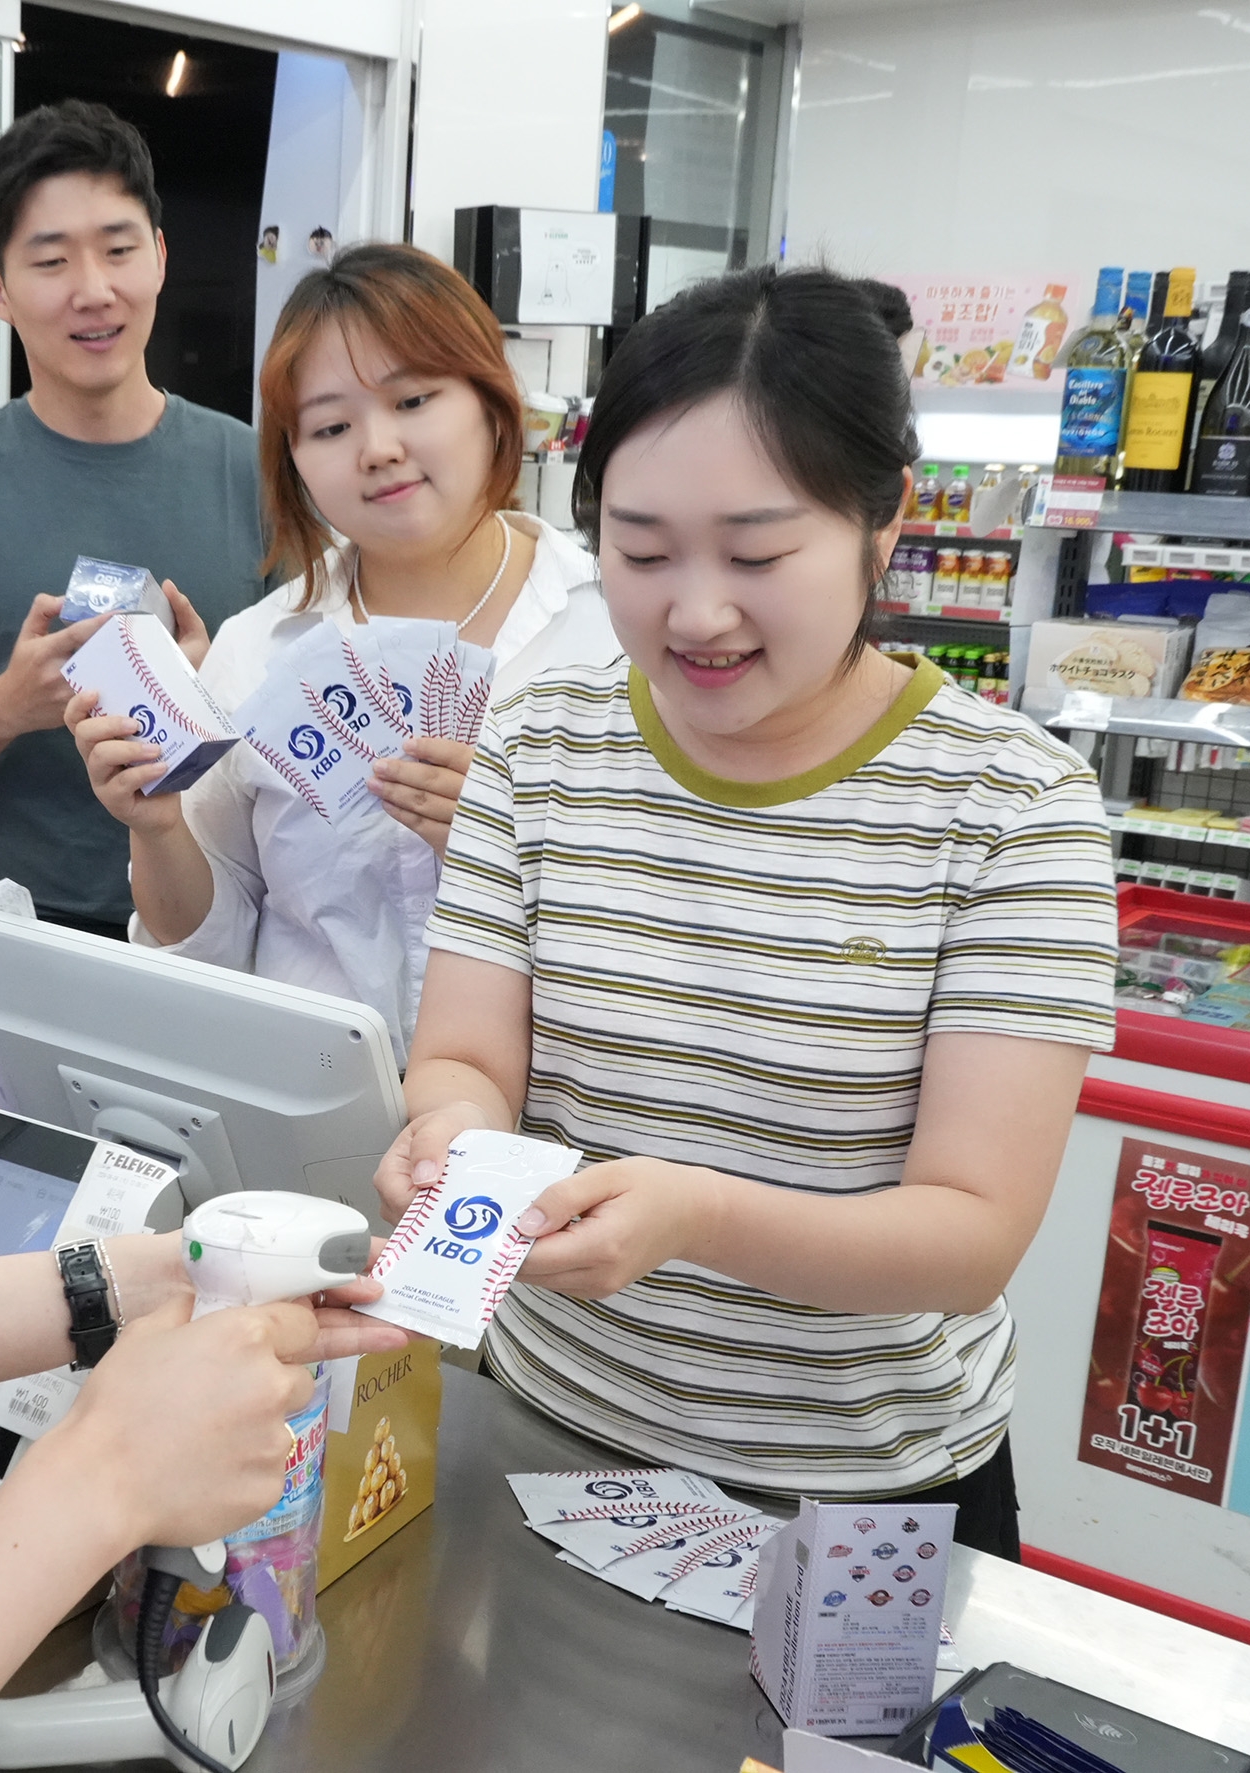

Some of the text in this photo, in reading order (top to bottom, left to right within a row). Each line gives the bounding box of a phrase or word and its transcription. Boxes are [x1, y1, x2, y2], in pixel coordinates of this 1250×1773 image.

[927, 286, 975, 299] 따뜻하게
[1049, 664, 1136, 679] ホワイトチョコラスク
[147, 729, 168, 745] BO
[350, 712, 371, 733] BO
[311, 748, 342, 780] KBO
[1131, 1169, 1250, 1217] 젤루조아
[423, 1237, 483, 1265] KBO
[391, 1289, 413, 1299] Official
[414, 1295, 444, 1309] Collection
[445, 1305, 460, 1314] Card
[402, 1285, 417, 1293] 2024
[432, 1293, 455, 1304] LEAGUE
[1142, 1277, 1205, 1316] 젤루
[1142, 1309, 1199, 1340] 조아
[357, 1354, 412, 1407] ROCHER
[1118, 1404, 1197, 1460] 1+1
[1091, 1434, 1213, 1483] 오직 세븐일레븐에서만
[631, 1480, 659, 1498] KBO
[779, 1591, 793, 1711] 2024 KBO LEAGUE
[785, 1564, 804, 1720] Official Collection Card
